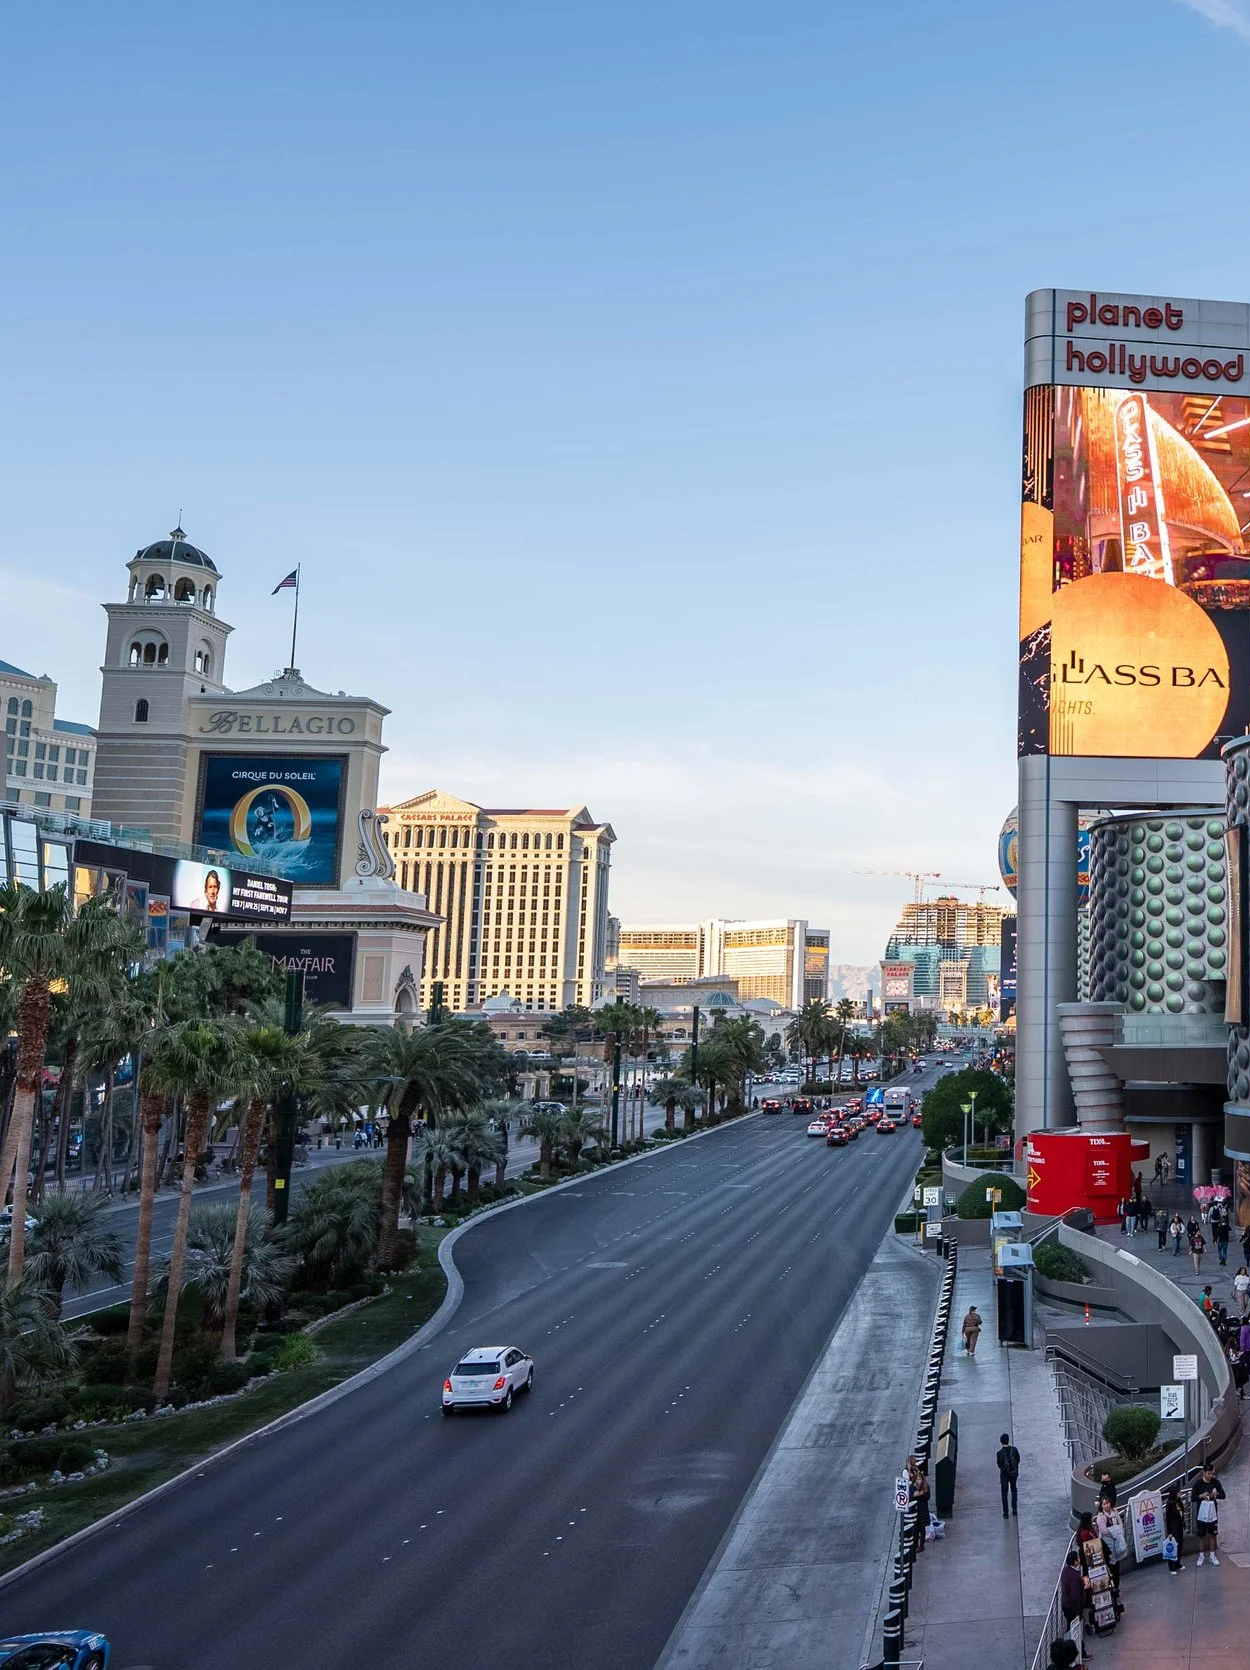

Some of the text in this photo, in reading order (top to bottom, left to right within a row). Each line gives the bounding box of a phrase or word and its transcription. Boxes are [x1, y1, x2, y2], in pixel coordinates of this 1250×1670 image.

[1066, 294, 1183, 332] planet
[1066, 340, 1244, 384] hollywood
[199, 711, 356, 735] BELLAGIO
[231, 771, 267, 781] CIRQUE
[271, 955, 335, 974] MAYFAIR
